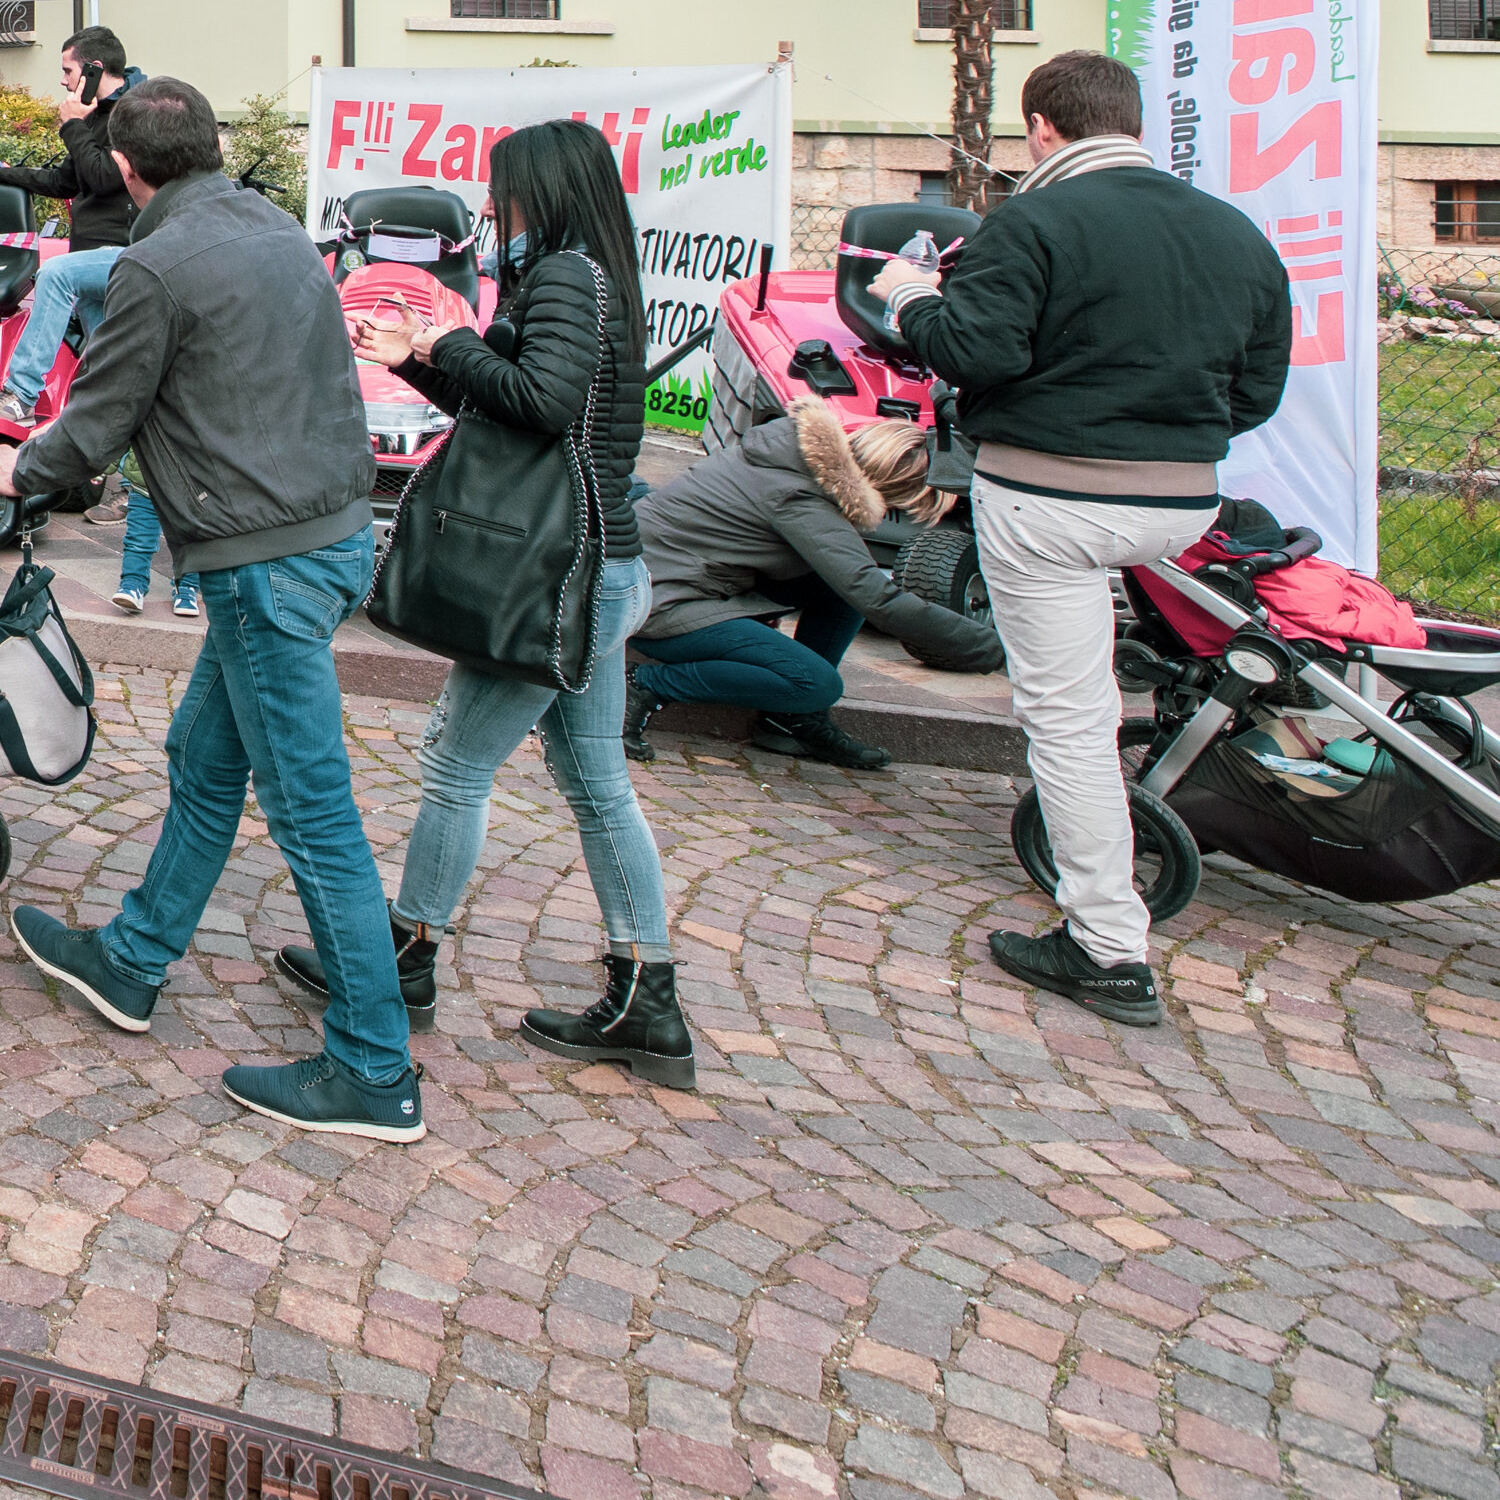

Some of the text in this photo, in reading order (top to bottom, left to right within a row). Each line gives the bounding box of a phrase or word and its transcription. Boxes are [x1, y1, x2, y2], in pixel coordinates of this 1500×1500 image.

[661, 108, 740, 151] Leader
[659, 137, 767, 191] nel verde
[640, 228, 757, 284] TIVATORI
[645, 388, 708, 421] 8250
[1079, 978, 1137, 988] salomon
